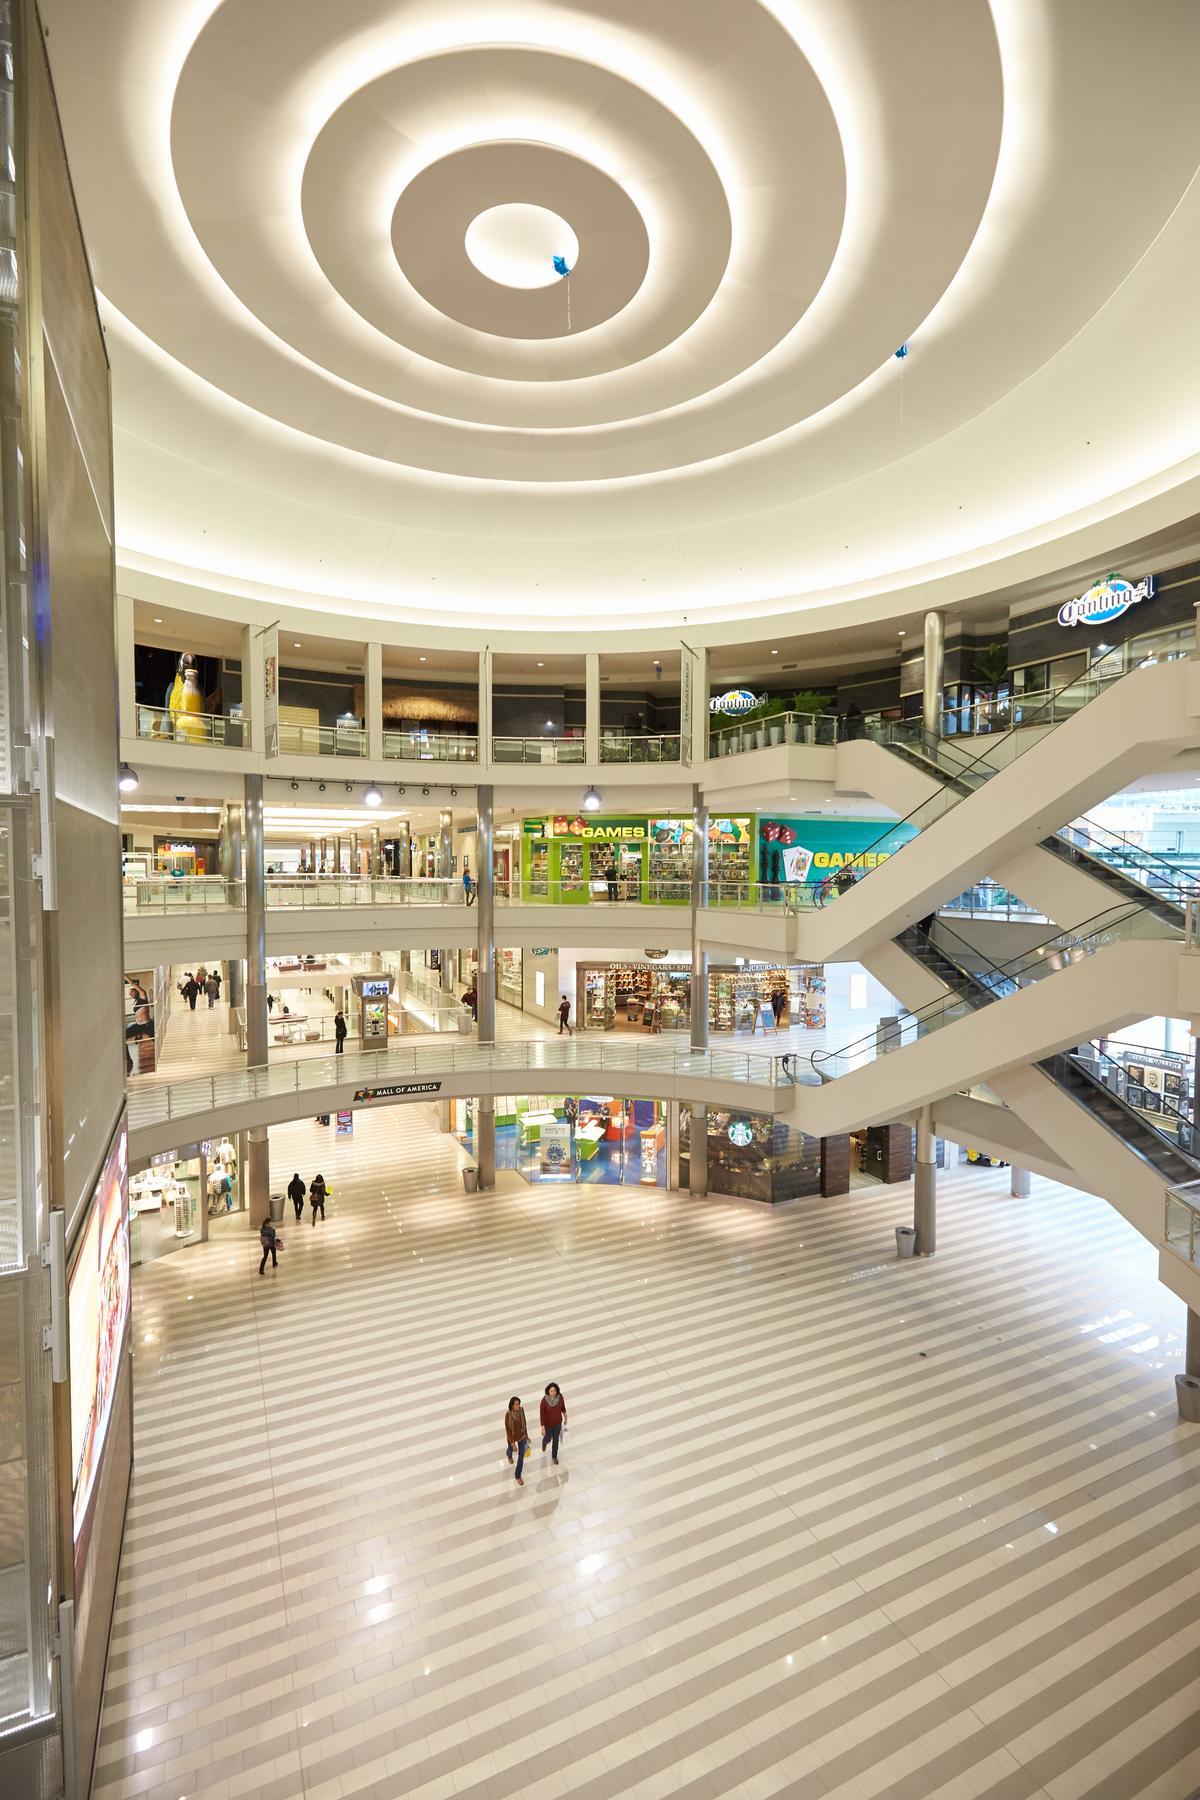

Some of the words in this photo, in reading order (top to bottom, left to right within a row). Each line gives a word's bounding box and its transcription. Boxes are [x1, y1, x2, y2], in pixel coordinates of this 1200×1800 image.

[581, 826, 645, 838] GAMES
[633, 963, 671, 971] VINEGARS
[407, 1084, 437, 1093] AMERICA
